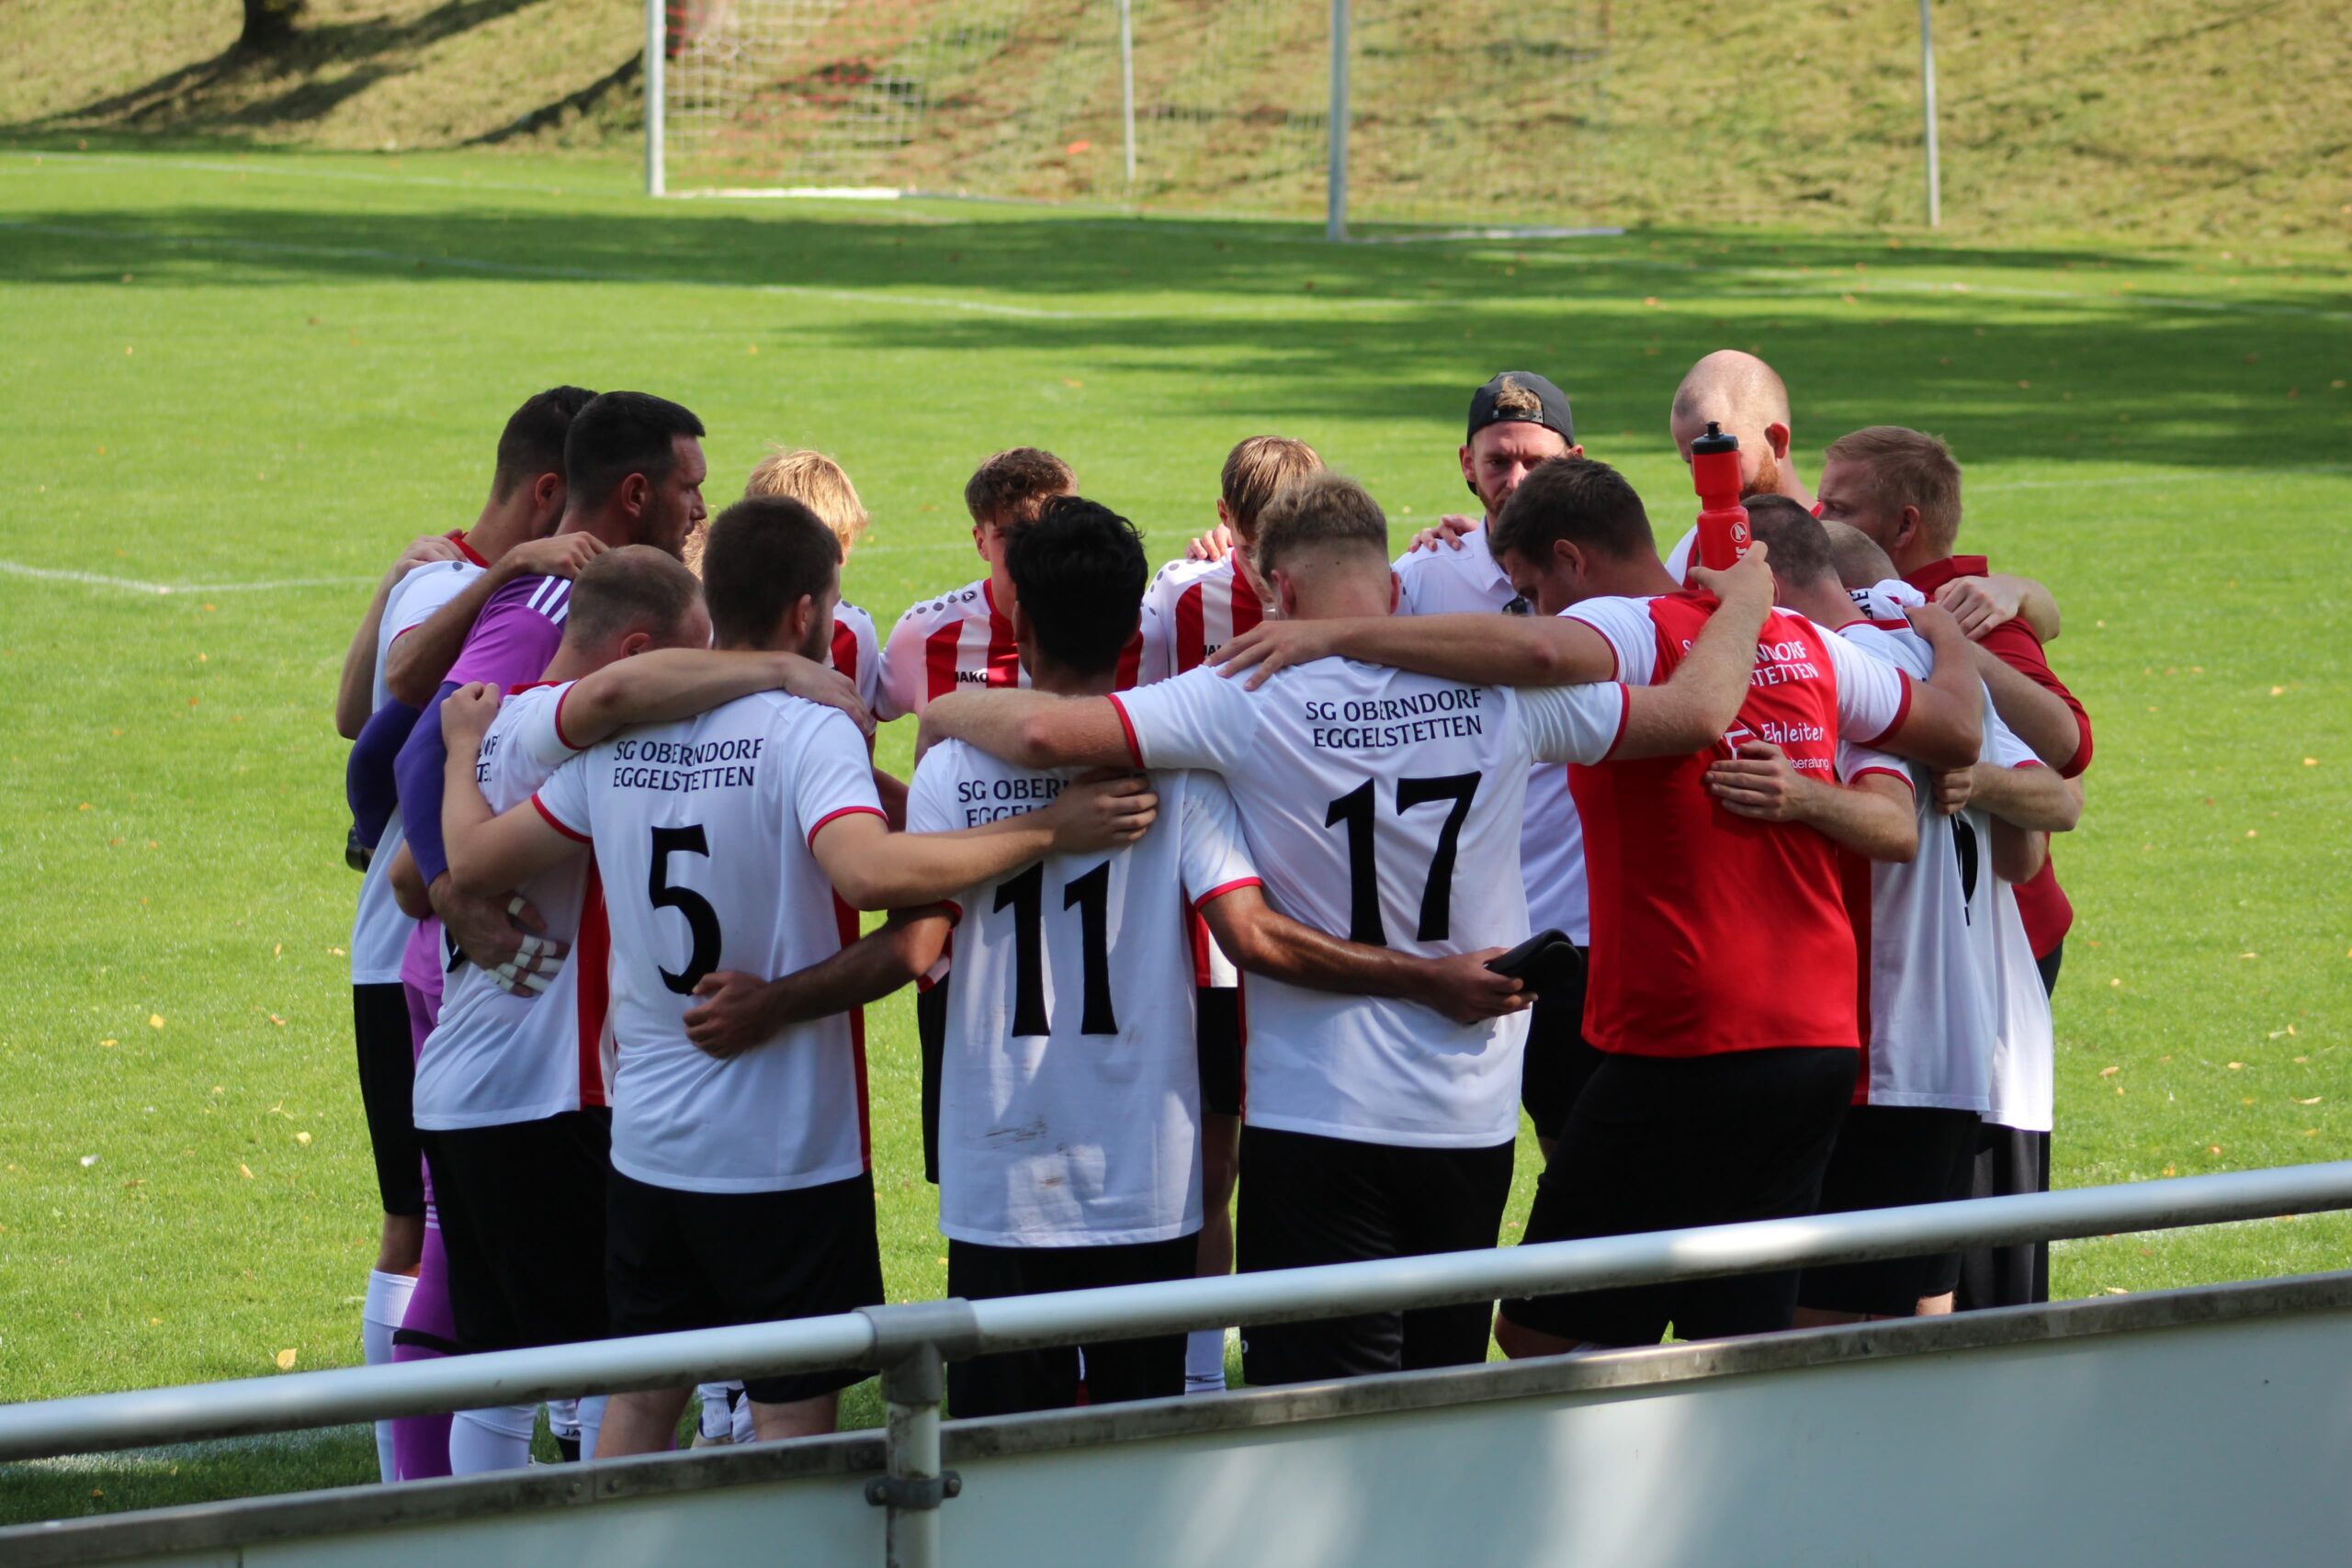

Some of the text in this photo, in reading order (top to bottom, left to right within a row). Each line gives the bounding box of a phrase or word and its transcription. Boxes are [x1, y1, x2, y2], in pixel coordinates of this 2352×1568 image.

[954, 671, 989, 682] JAKO
[1306, 688, 1481, 722] SG OBERNDORF
[1313, 715, 1482, 749] EGGELSTETTEN
[1761, 721, 1824, 743] Ehleiter
[614, 738, 764, 767] SG OBERNDORF
[1788, 757, 1829, 771] beratung
[613, 766, 754, 793] EGGELSTETTEN
[958, 780, 987, 803] SG
[1325, 771, 1482, 946] 17
[649, 823, 722, 997] 5
[993, 860, 1119, 1037] 11
